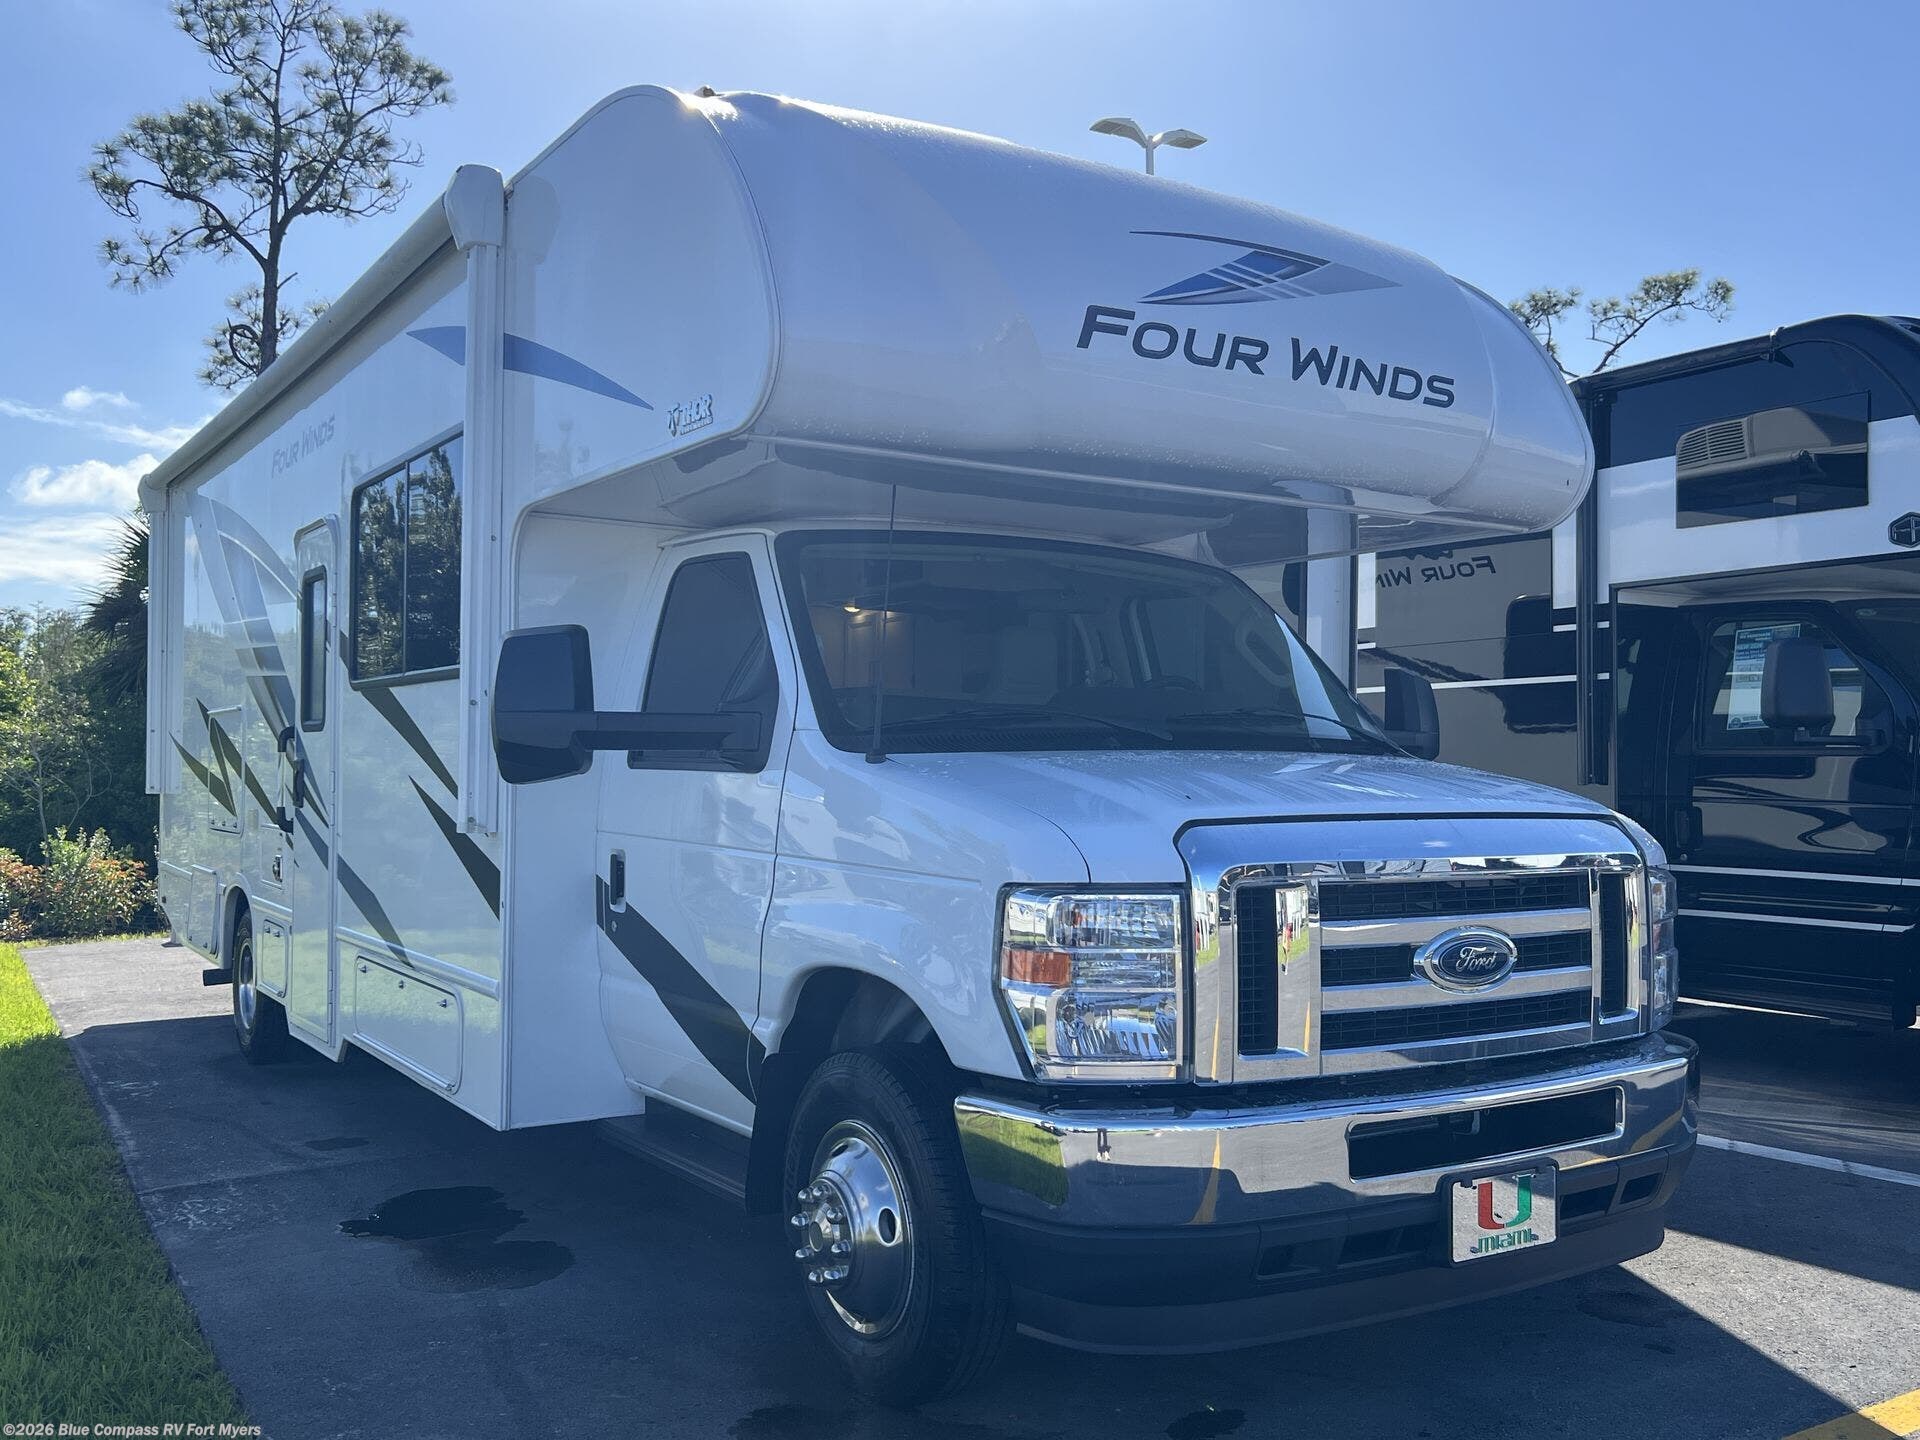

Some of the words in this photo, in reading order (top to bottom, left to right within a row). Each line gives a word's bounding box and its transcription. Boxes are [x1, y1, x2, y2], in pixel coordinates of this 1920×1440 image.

[1076, 304, 1270, 375] FOUR
[1290, 336, 1456, 409] WINDS
[271, 440, 300, 479] FOUR
[301, 413, 336, 458] WINDS
[1455, 946, 1498, 973] Ford
